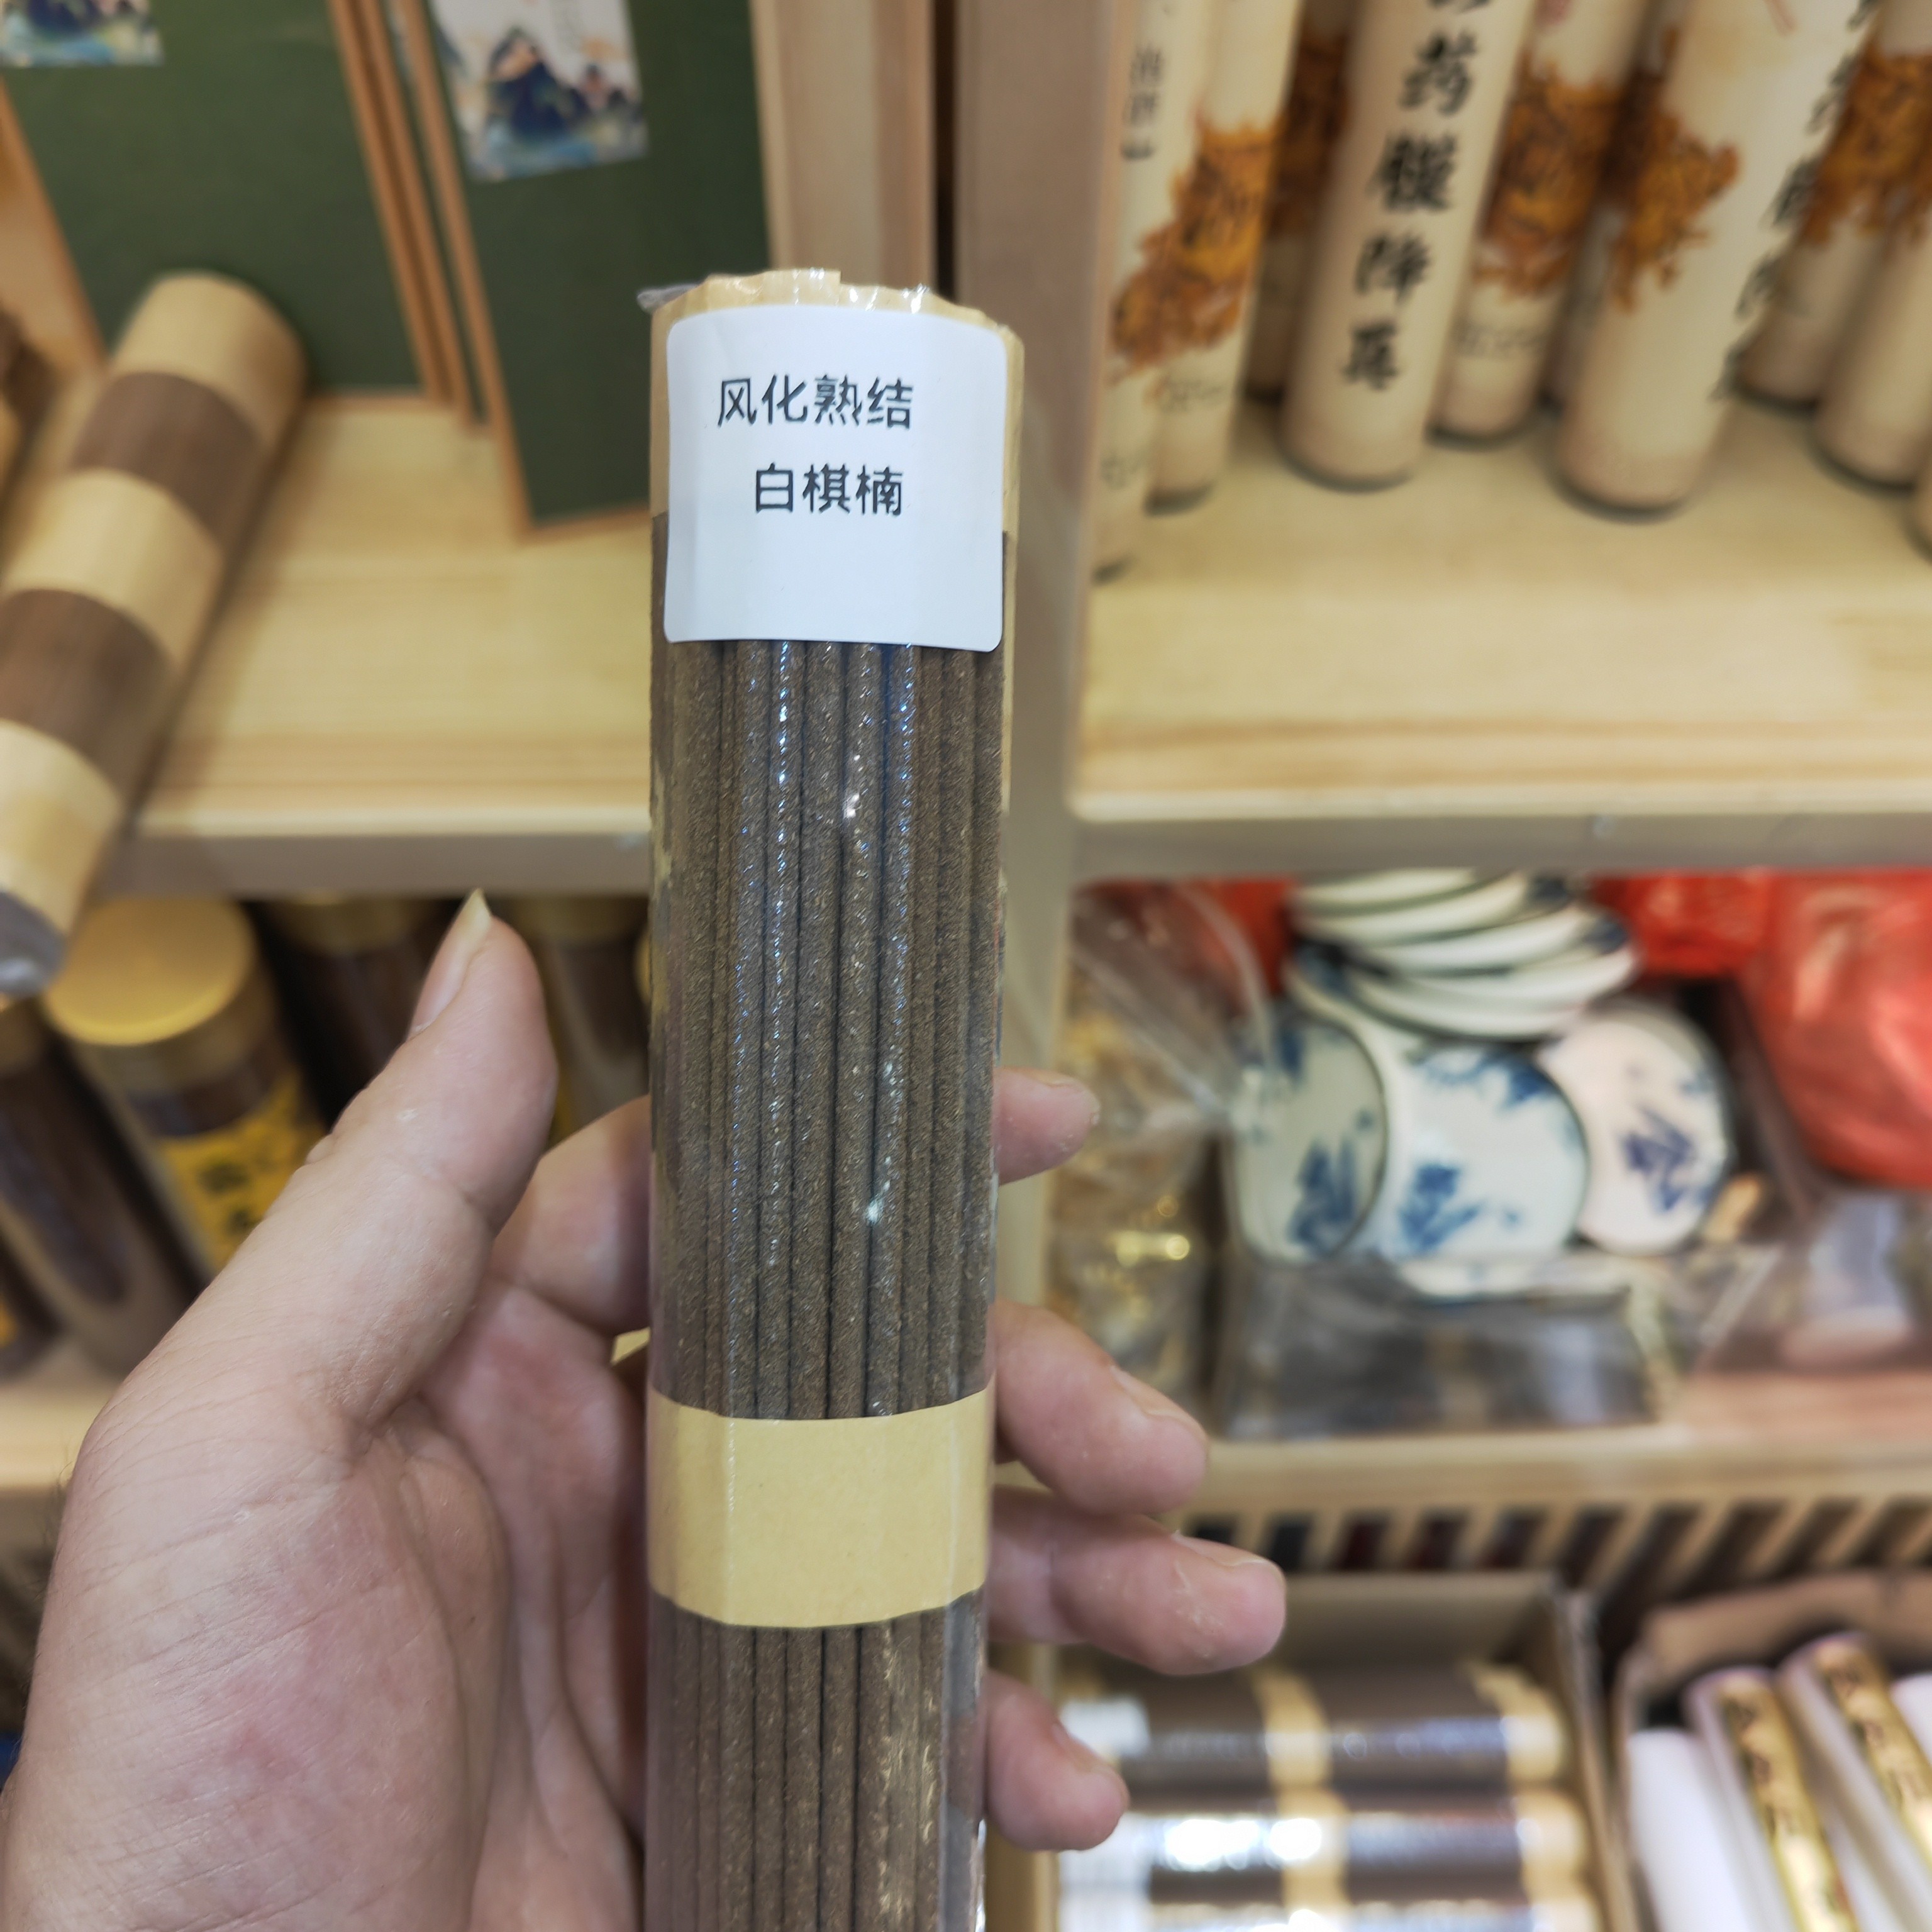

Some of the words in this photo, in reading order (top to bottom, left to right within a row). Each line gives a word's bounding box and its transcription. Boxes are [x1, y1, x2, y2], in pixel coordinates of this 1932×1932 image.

[718, 374, 913, 430] 风化熟结
[756, 462, 902, 516] 白棋楠
